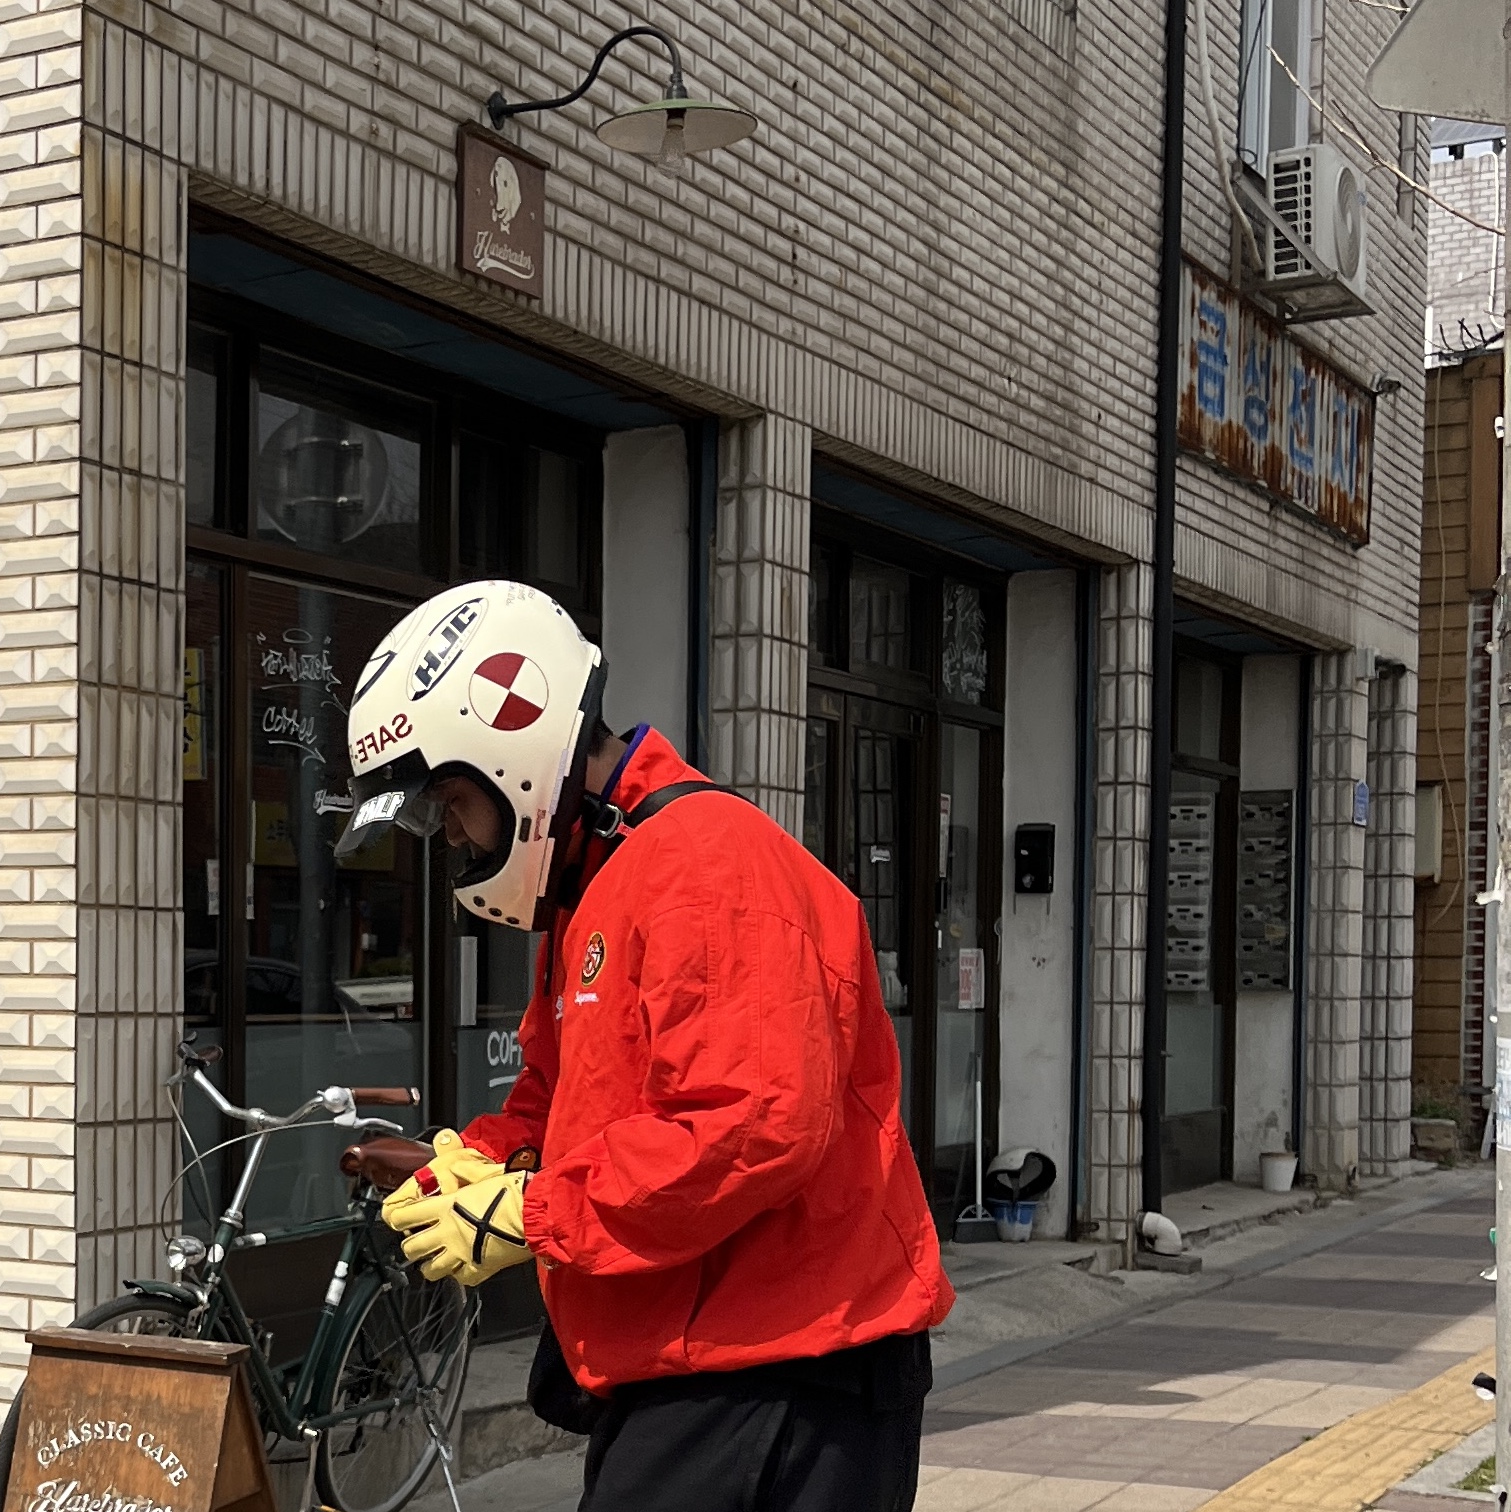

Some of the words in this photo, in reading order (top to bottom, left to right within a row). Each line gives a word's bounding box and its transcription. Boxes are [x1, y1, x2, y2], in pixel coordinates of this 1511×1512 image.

[414, 604, 478, 687] HJC
[37, 1420, 133, 1468] CLASSIC
[137, 1431, 188, 1487] CAFE
